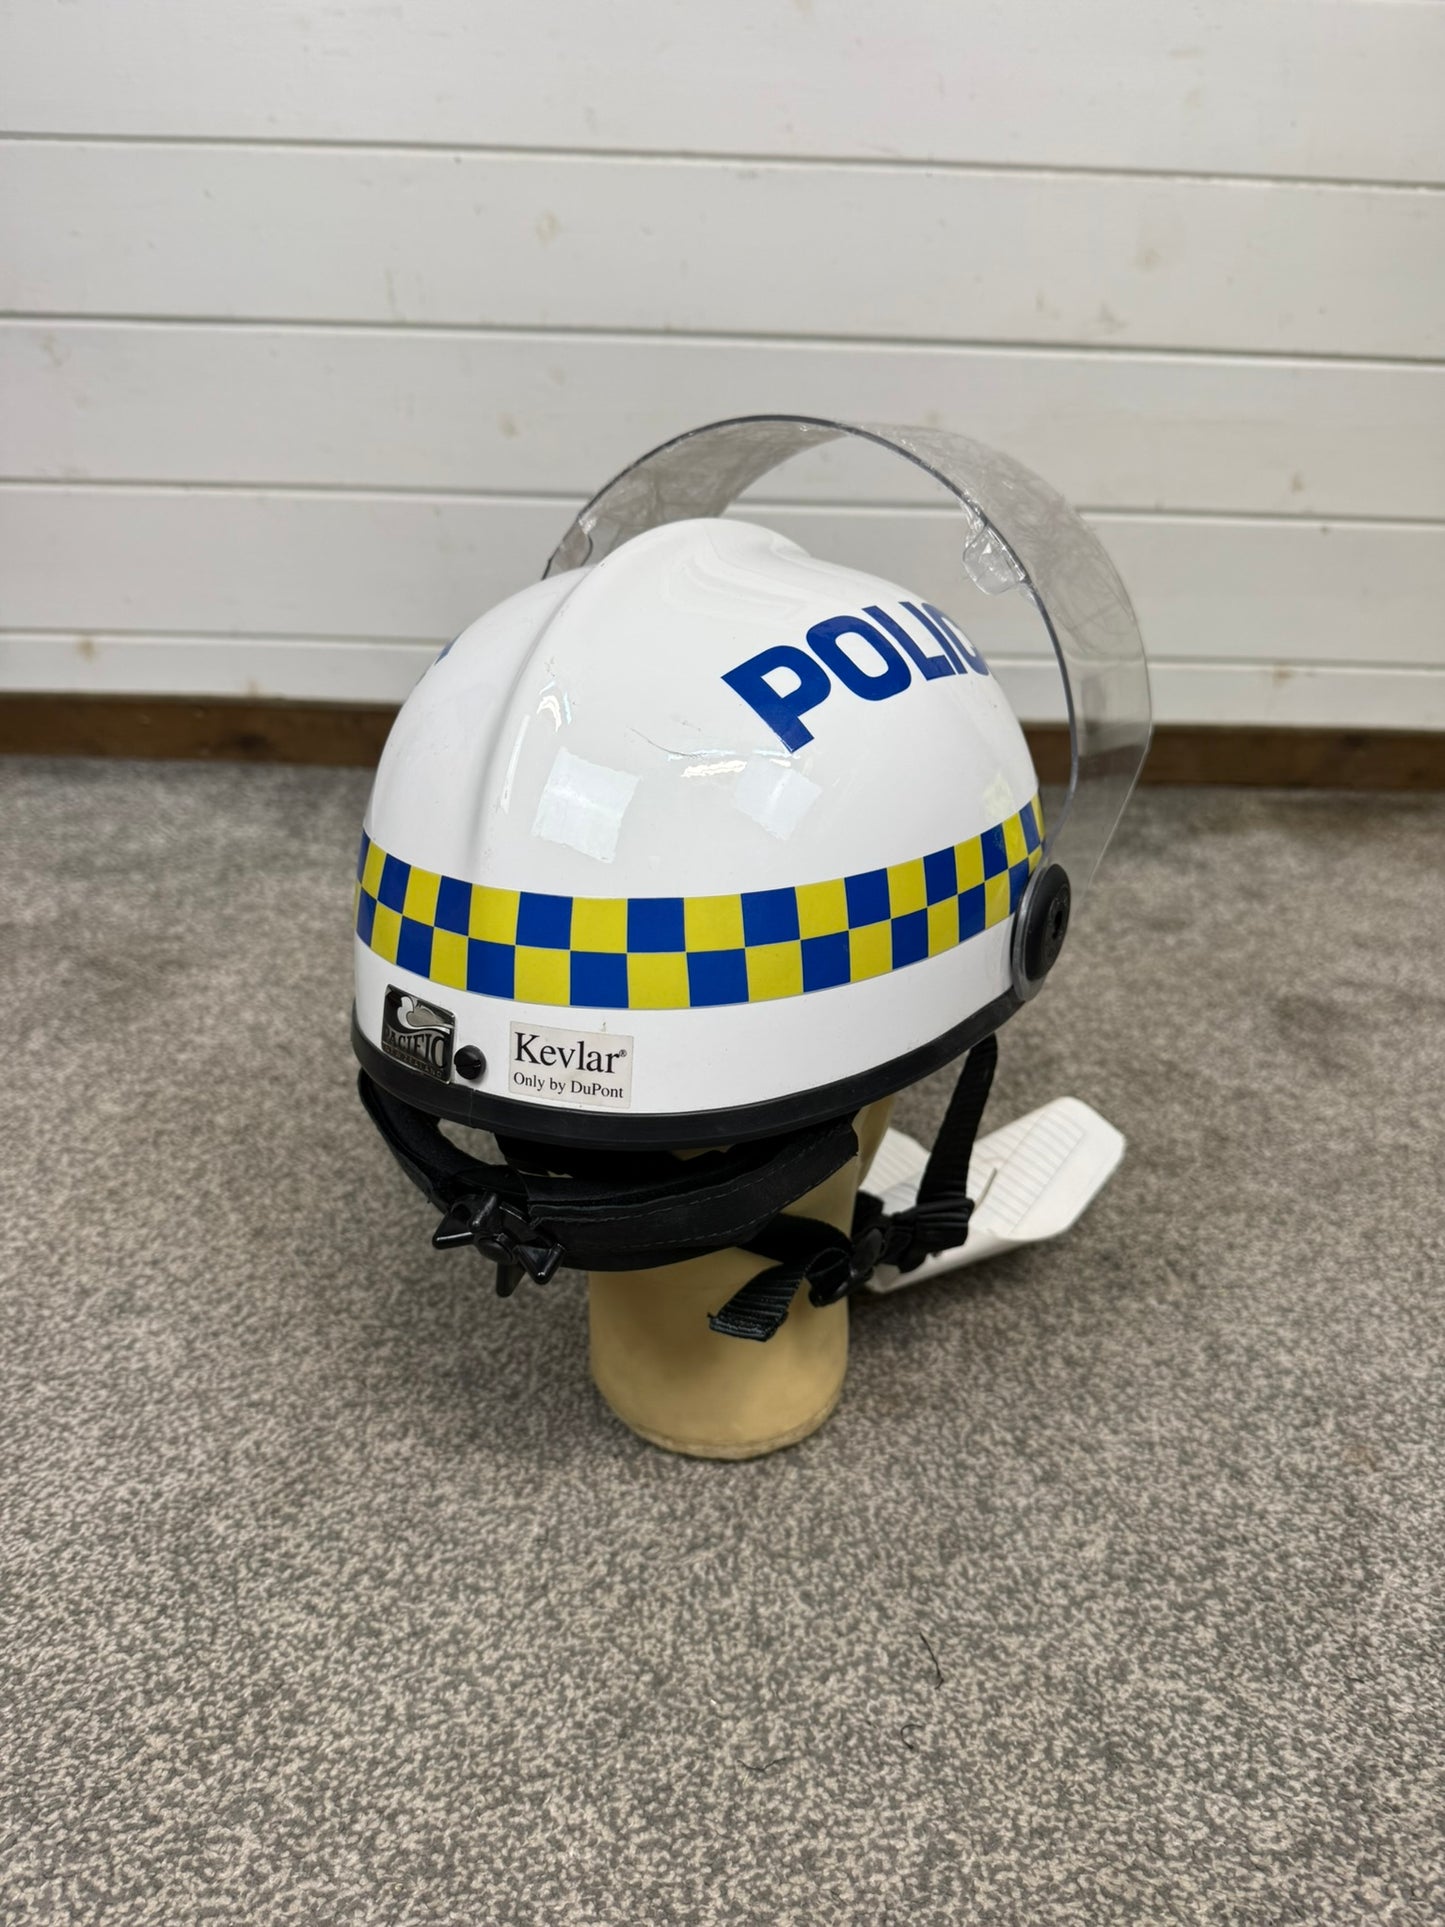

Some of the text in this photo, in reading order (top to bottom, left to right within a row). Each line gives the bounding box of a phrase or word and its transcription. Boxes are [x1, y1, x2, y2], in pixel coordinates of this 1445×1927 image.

[721, 601, 989, 754] POLIC
[383, 1026, 447, 1068] PACIFIC
[513, 1072, 624, 1099] Only by DuPont
